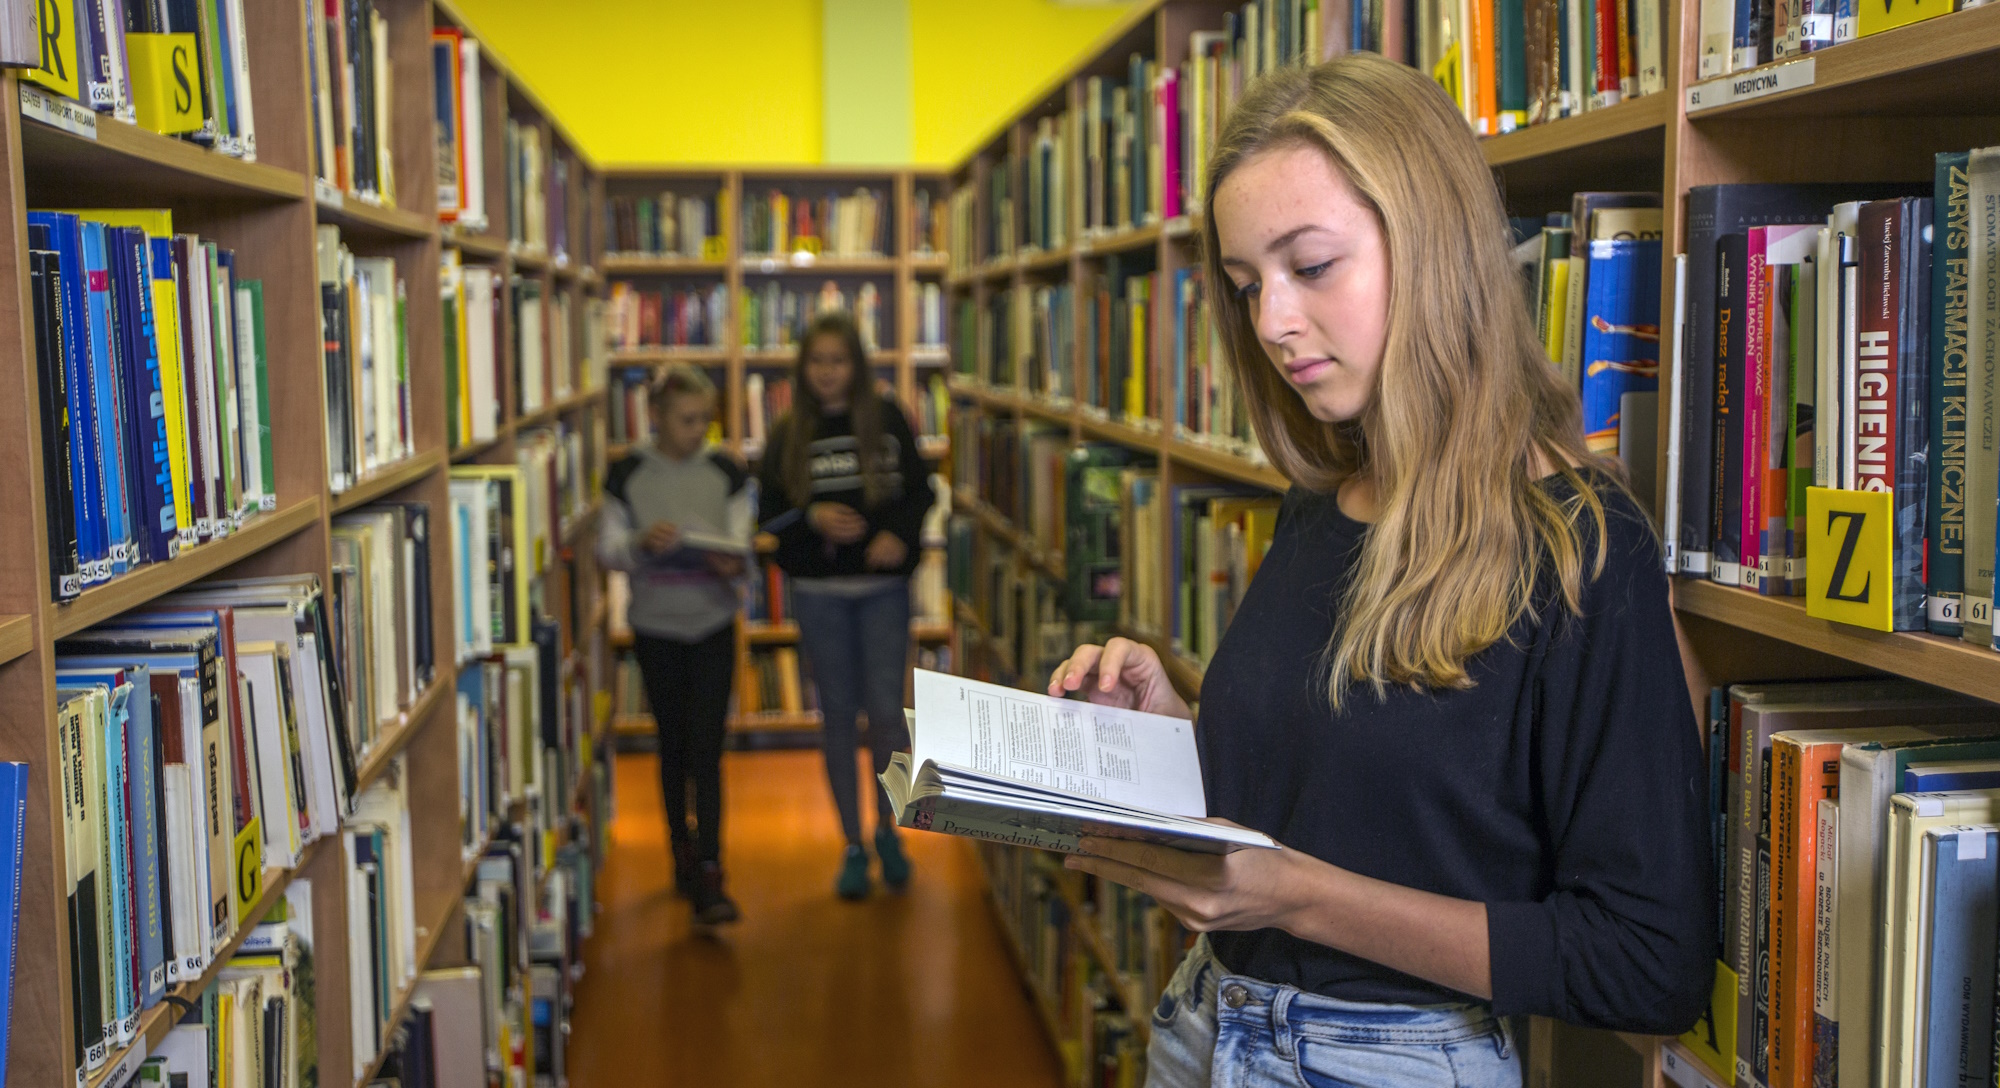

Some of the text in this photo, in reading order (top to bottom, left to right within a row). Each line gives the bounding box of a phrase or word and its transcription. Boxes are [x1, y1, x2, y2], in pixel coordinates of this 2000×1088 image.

[40, 0, 68, 83] R
[1788, 30, 1796, 43] 61
[1801, 21, 1816, 37] 61
[1837, 22, 1848, 38] 61
[172, 44, 192, 116] S
[1691, 73, 1778, 105] 61 MEDYCYNA
[74, 110, 96, 129] REKLAMA
[1881, 217, 1892, 320] Maciej Zaremba Bielawski
[1747, 253, 1757, 357] WYNIKI BADAŃ
[1754, 253, 1765, 396] JAK INTERPRETOWAĆ
[1981, 194, 1996, 452] STOMATOLOGII ZACHOWAWCZEJ
[1716, 308, 1731, 415] Dasz radę!
[1763, 332, 1771, 365] Choroby
[1940, 165, 1969, 555] ZARYS FARMACJI KLINICZNEJ
[1761, 396, 1769, 452] pokarmowego
[1680, 555, 1691, 568] 61
[1712, 564, 1722, 579] 61
[1746, 570, 1756, 585] 61
[1759, 559, 1769, 571] 61
[1825, 510, 1871, 604] Z
[1942, 602, 1961, 619] 61
[1973, 602, 1987, 620] 61
[115, 763, 124, 822] polskiego
[208, 741, 219, 837] metalurgia
[1743, 729, 1753, 831] WITOLD BIAŁY
[118, 825, 126, 885] przemysłu
[142, 736, 157, 938] CHEMIA PRAKTYCZNA
[943, 820, 1041, 848] Przewodnik
[1048, 838, 1072, 852] do
[1776, 751, 1787, 903] ELEKTROTECHNIKA
[1819, 818, 1827, 862] Bogacki
[1826, 825, 1834, 862] Michał
[101, 782, 115, 977] po dziejach przemysłu polskiego
[237, 836, 257, 904] G
[123, 939, 129, 955] po
[1738, 847, 1752, 997] maszynoznawstwo
[186, 956, 202, 970] 66
[1774, 908, 1784, 1021] TEORETYCZNA
[1774, 1027, 1782, 1063] TOM
[1959, 976, 1972, 1072] DOM WYDAWNICZY
[1736, 1060, 1746, 1078] 62
